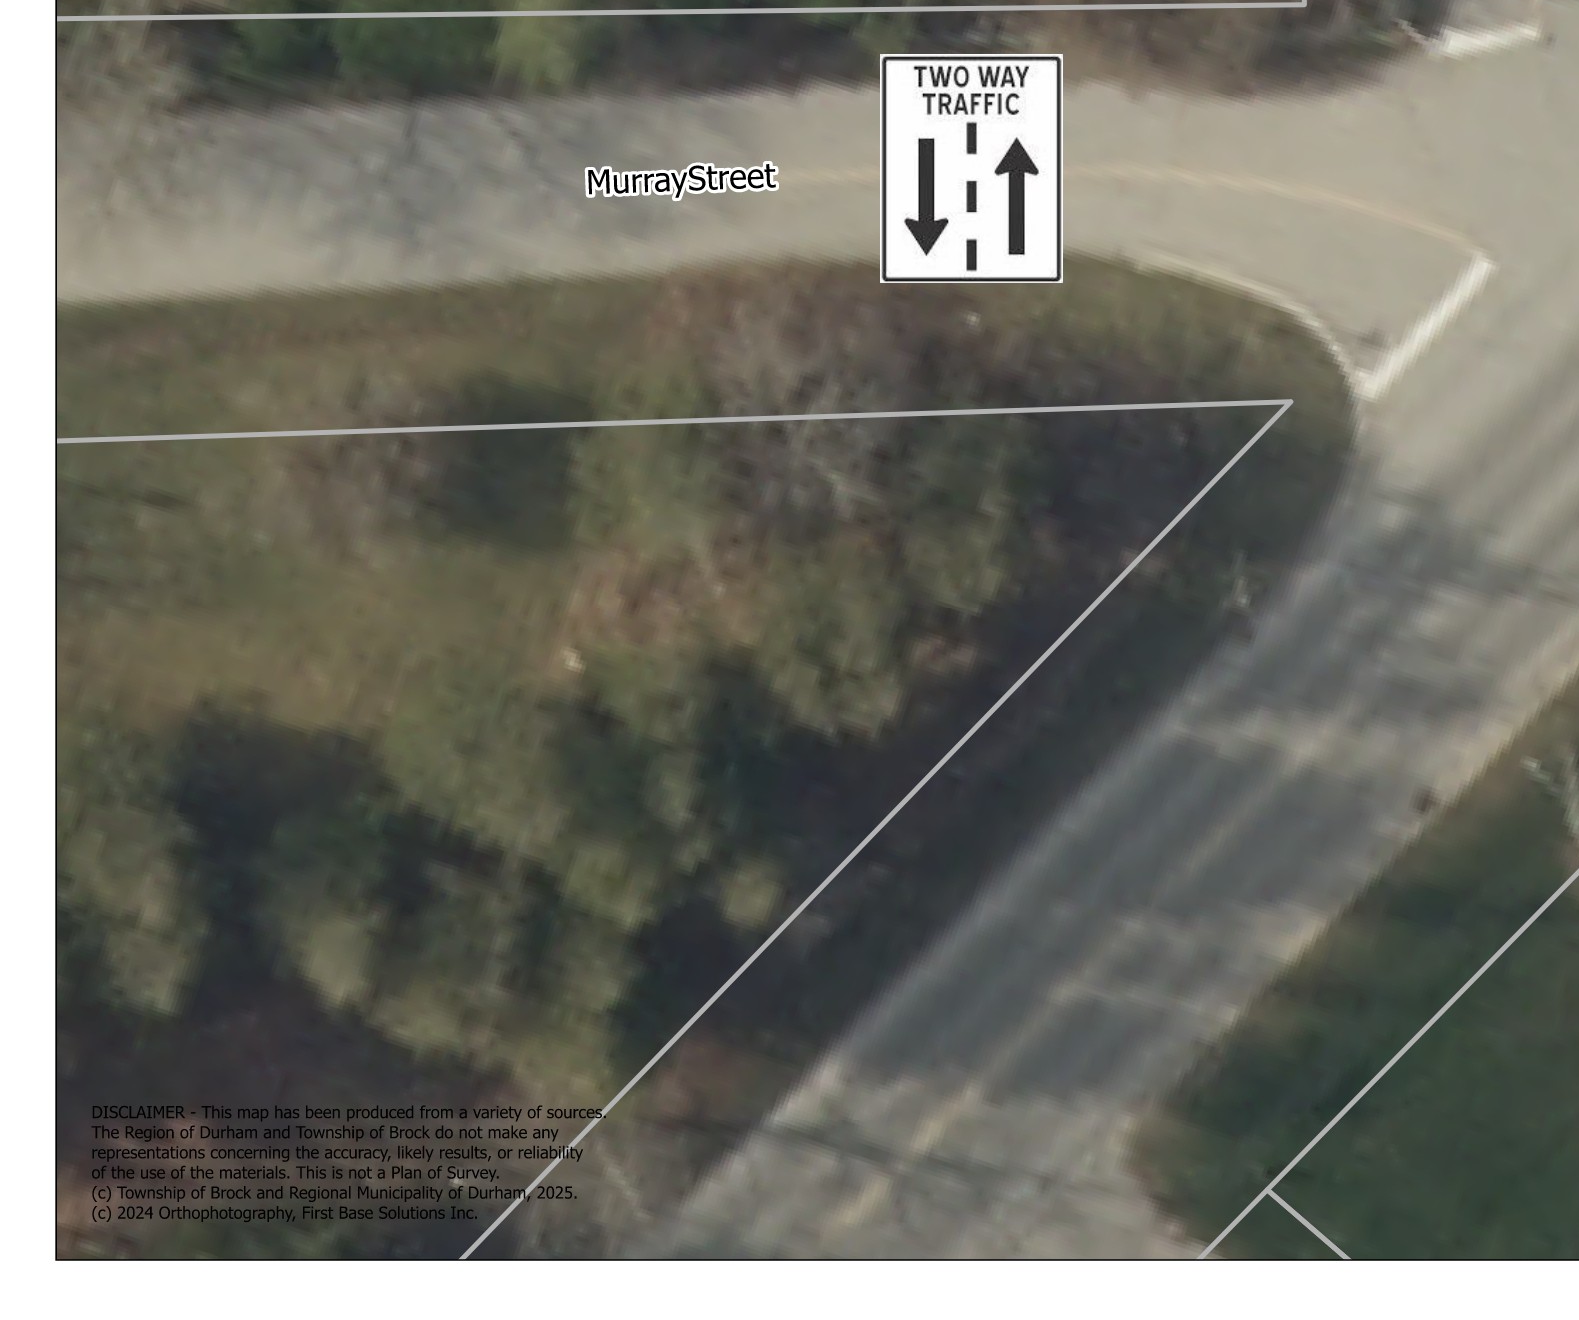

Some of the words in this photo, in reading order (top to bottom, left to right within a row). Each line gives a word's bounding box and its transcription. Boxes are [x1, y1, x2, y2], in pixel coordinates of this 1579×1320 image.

[913, 65, 970, 89] TWO
[978, 65, 1030, 89] WAY
[922, 92, 1021, 116] TRAFFIC
